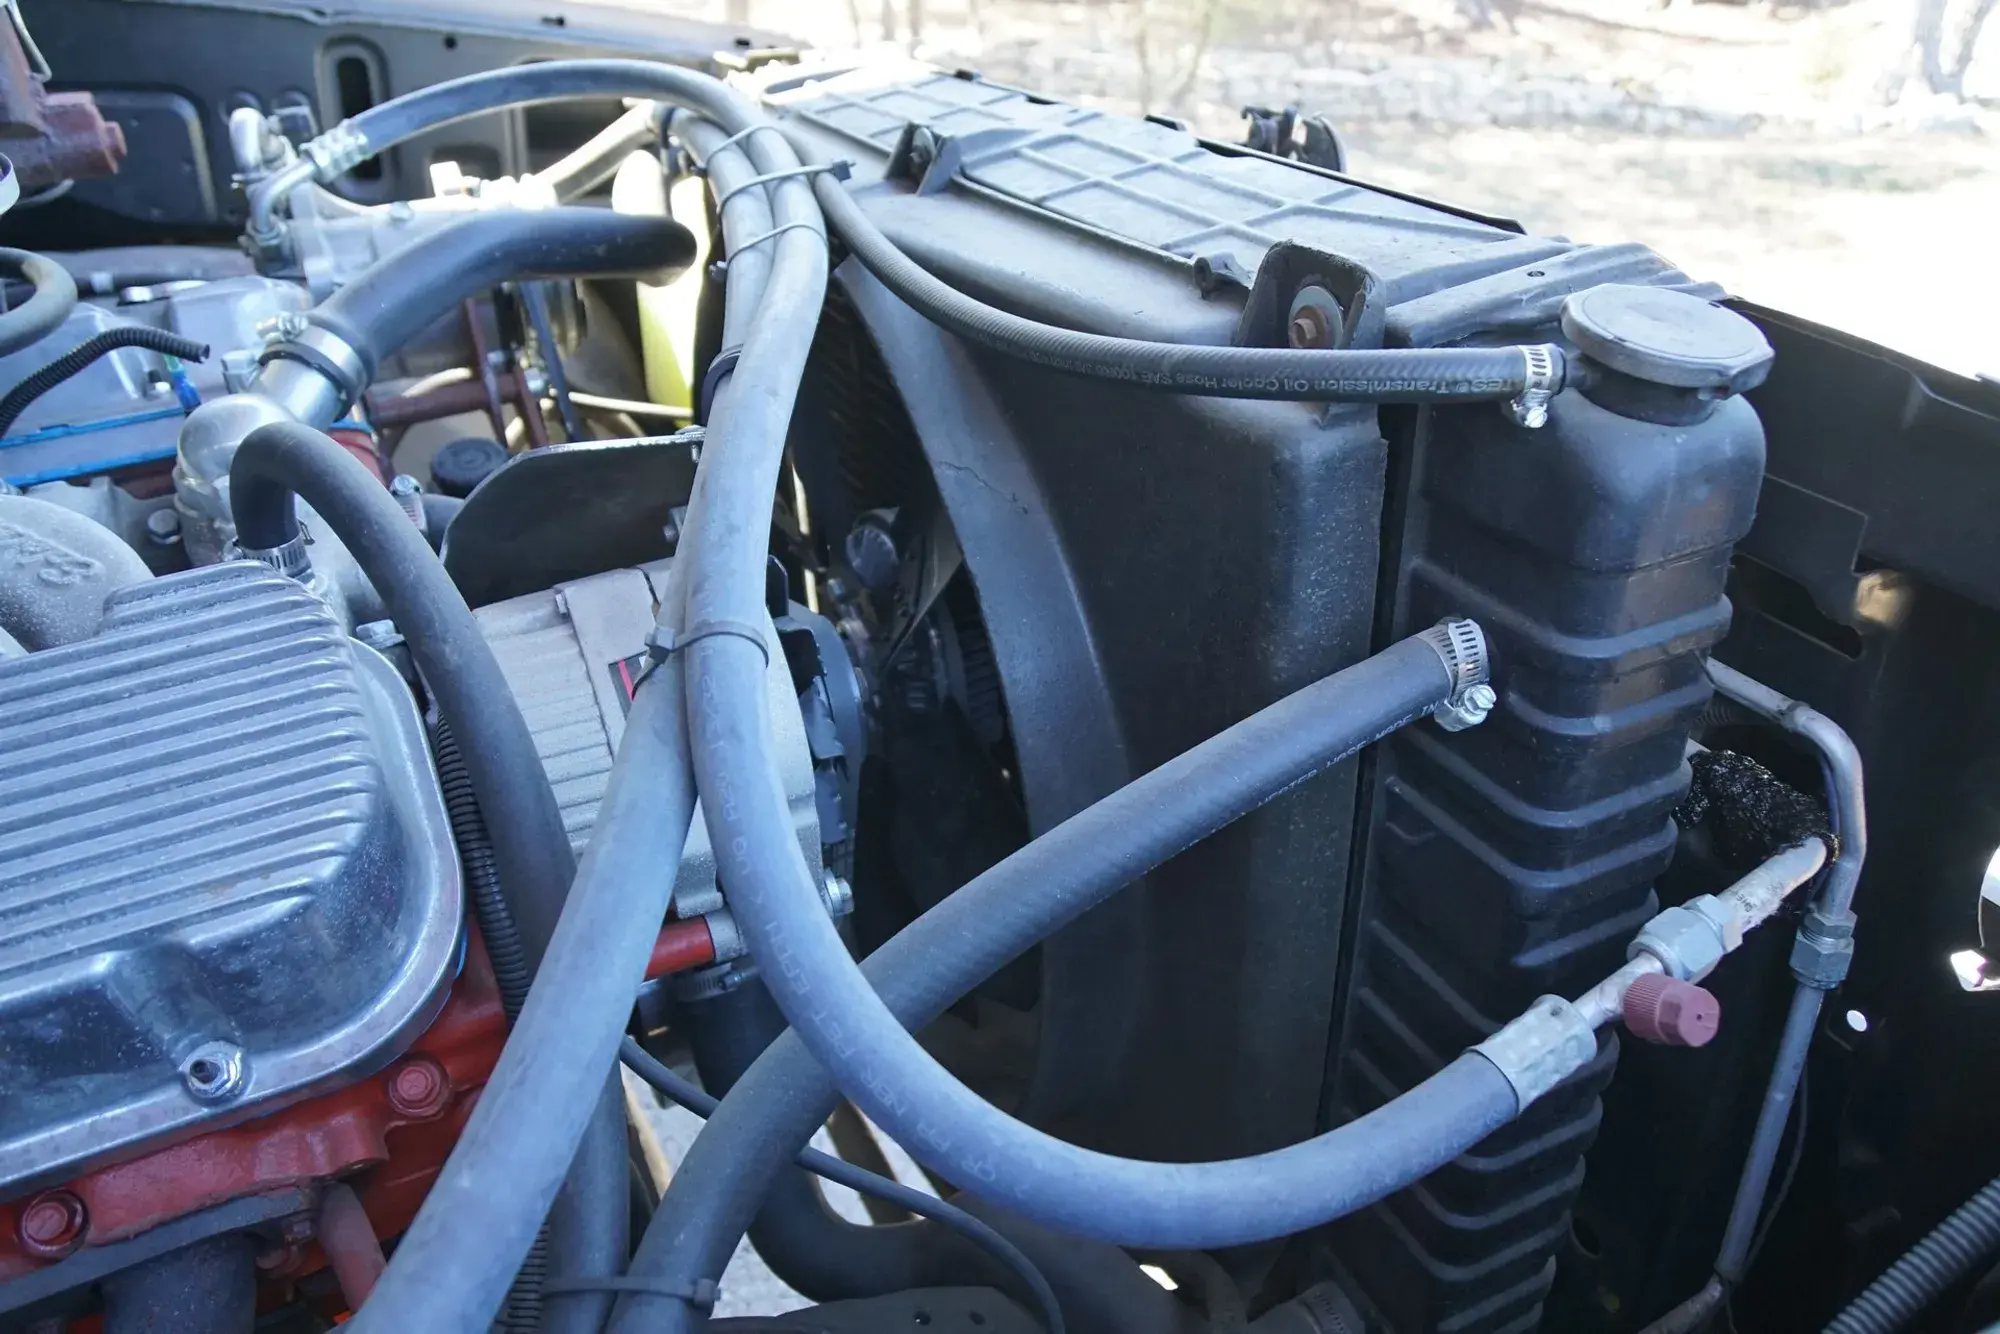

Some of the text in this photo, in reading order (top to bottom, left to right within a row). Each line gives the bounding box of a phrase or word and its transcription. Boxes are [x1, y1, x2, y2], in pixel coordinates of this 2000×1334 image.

[1175, 371, 1218, 389] Hose
[1220, 374, 1279, 392] Cooler
[1283, 378, 1308, 391] Oil
[1313, 379, 1449, 394] Transmission
